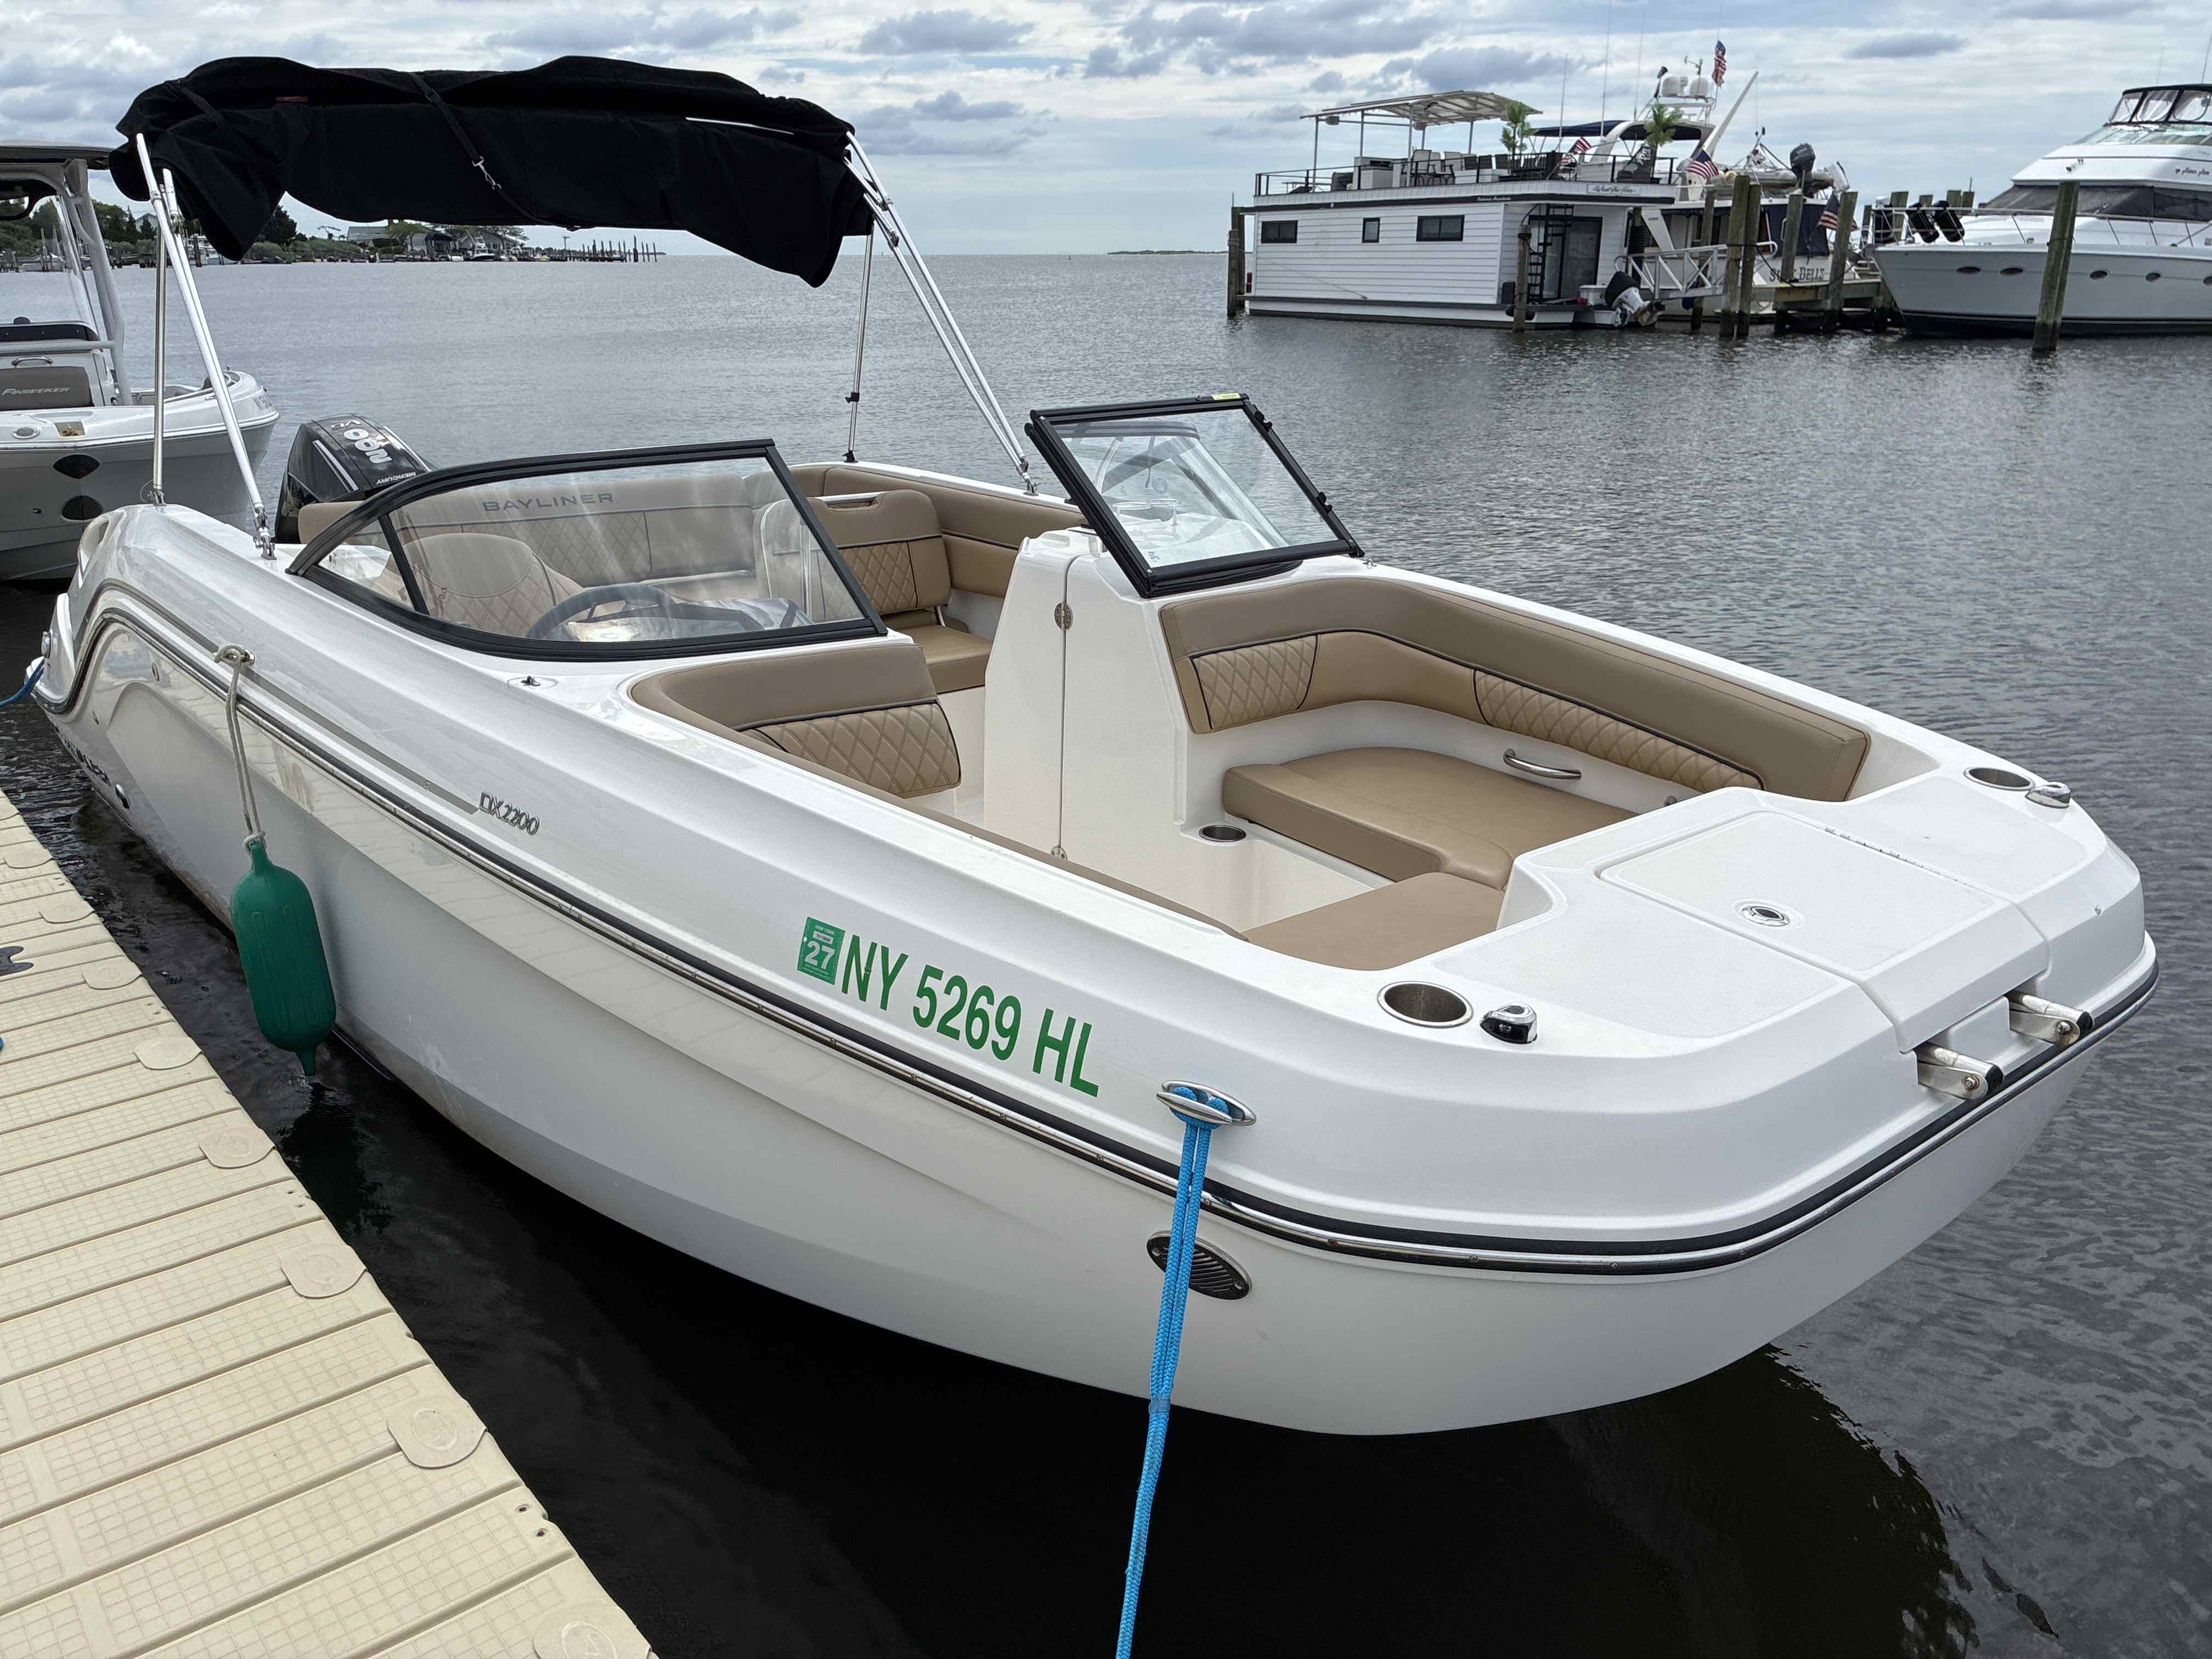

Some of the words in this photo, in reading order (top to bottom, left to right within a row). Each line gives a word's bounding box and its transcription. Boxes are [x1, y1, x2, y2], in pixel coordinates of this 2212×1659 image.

[343, 428, 392, 464] 200
[376, 472, 416, 485] MERCURY
[483, 493, 614, 511] BAYLINER
[479, 791, 539, 836] DX2200
[805, 941, 835, 969] 27
[841, 934, 909, 1011] NY
[913, 964, 1022, 1060] 5269
[1032, 1008, 1099, 1097] HL
